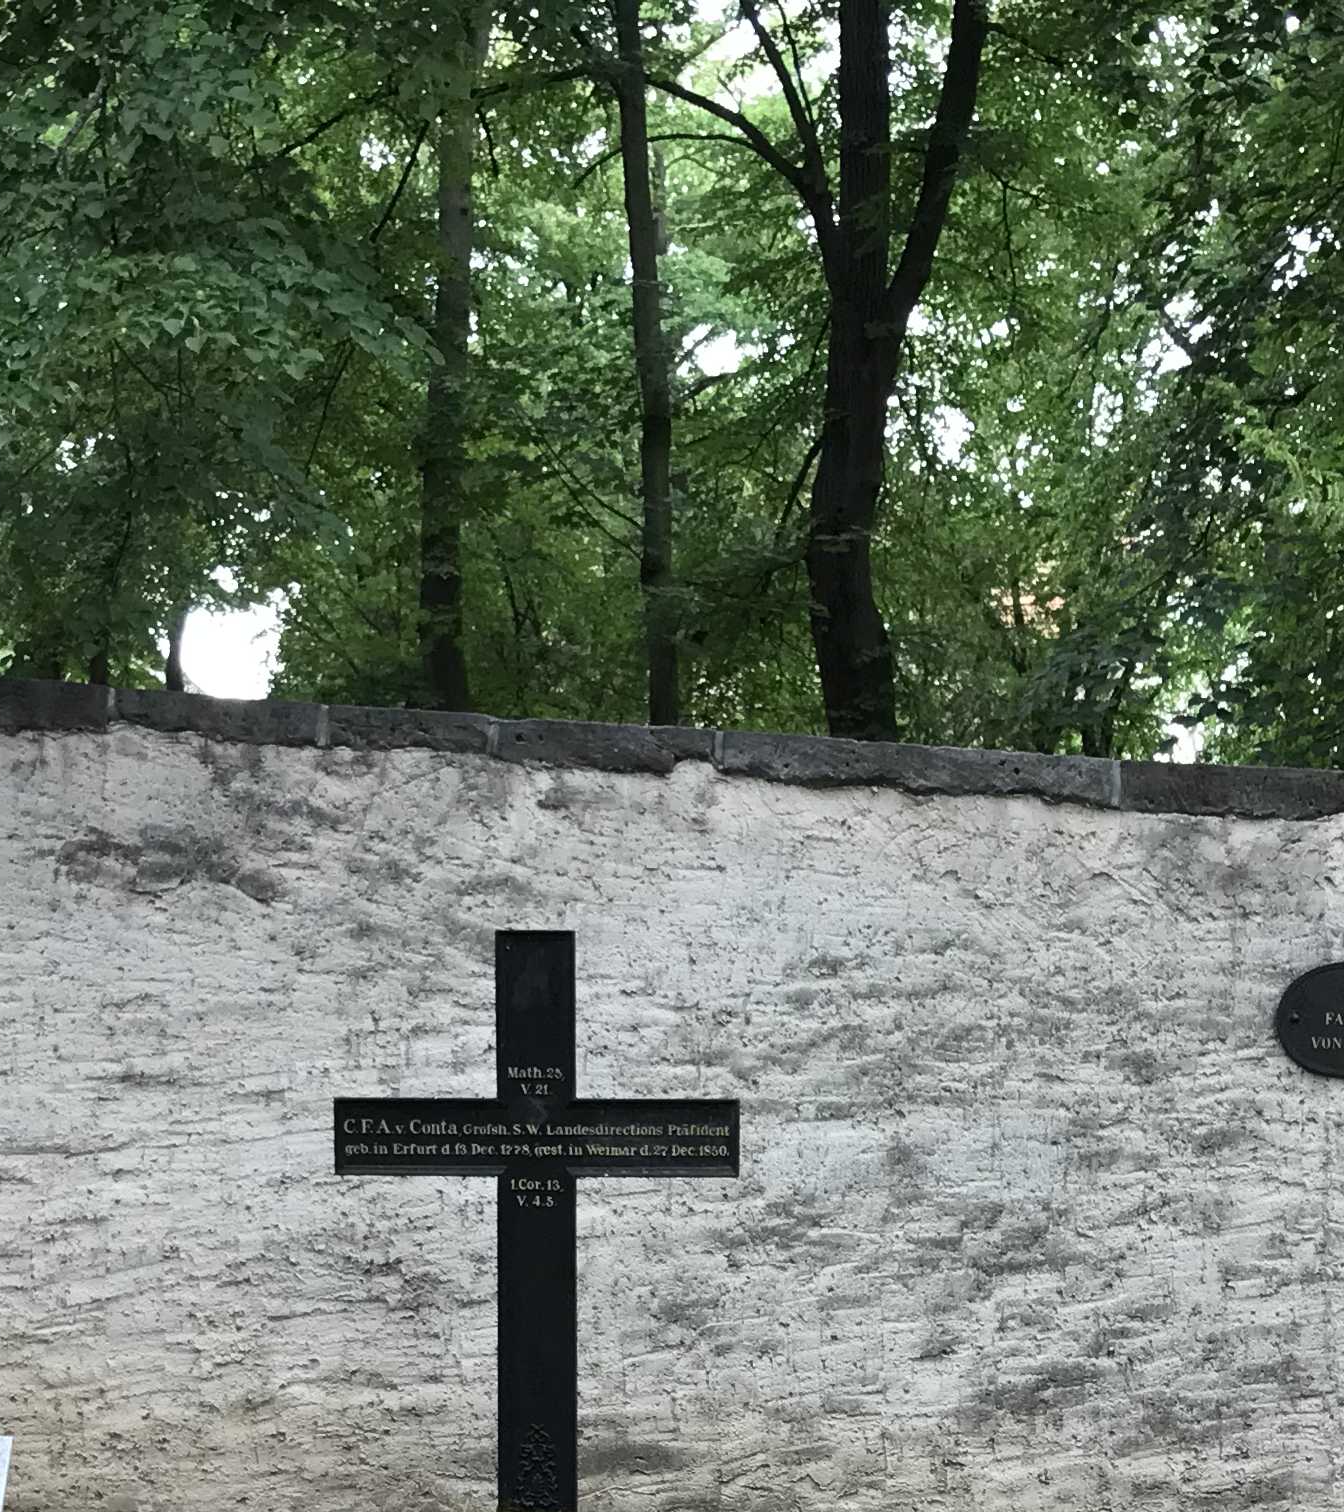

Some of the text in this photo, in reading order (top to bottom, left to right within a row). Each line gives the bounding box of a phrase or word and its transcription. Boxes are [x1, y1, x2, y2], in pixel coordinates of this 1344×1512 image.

[1311, 1037, 1342, 1049] VON
[373, 1143, 388, 1154] in
[393, 1144, 437, 1155] Erfurt
[568, 1144, 583, 1156] in
[586, 1145, 636, 1156] Weimar
